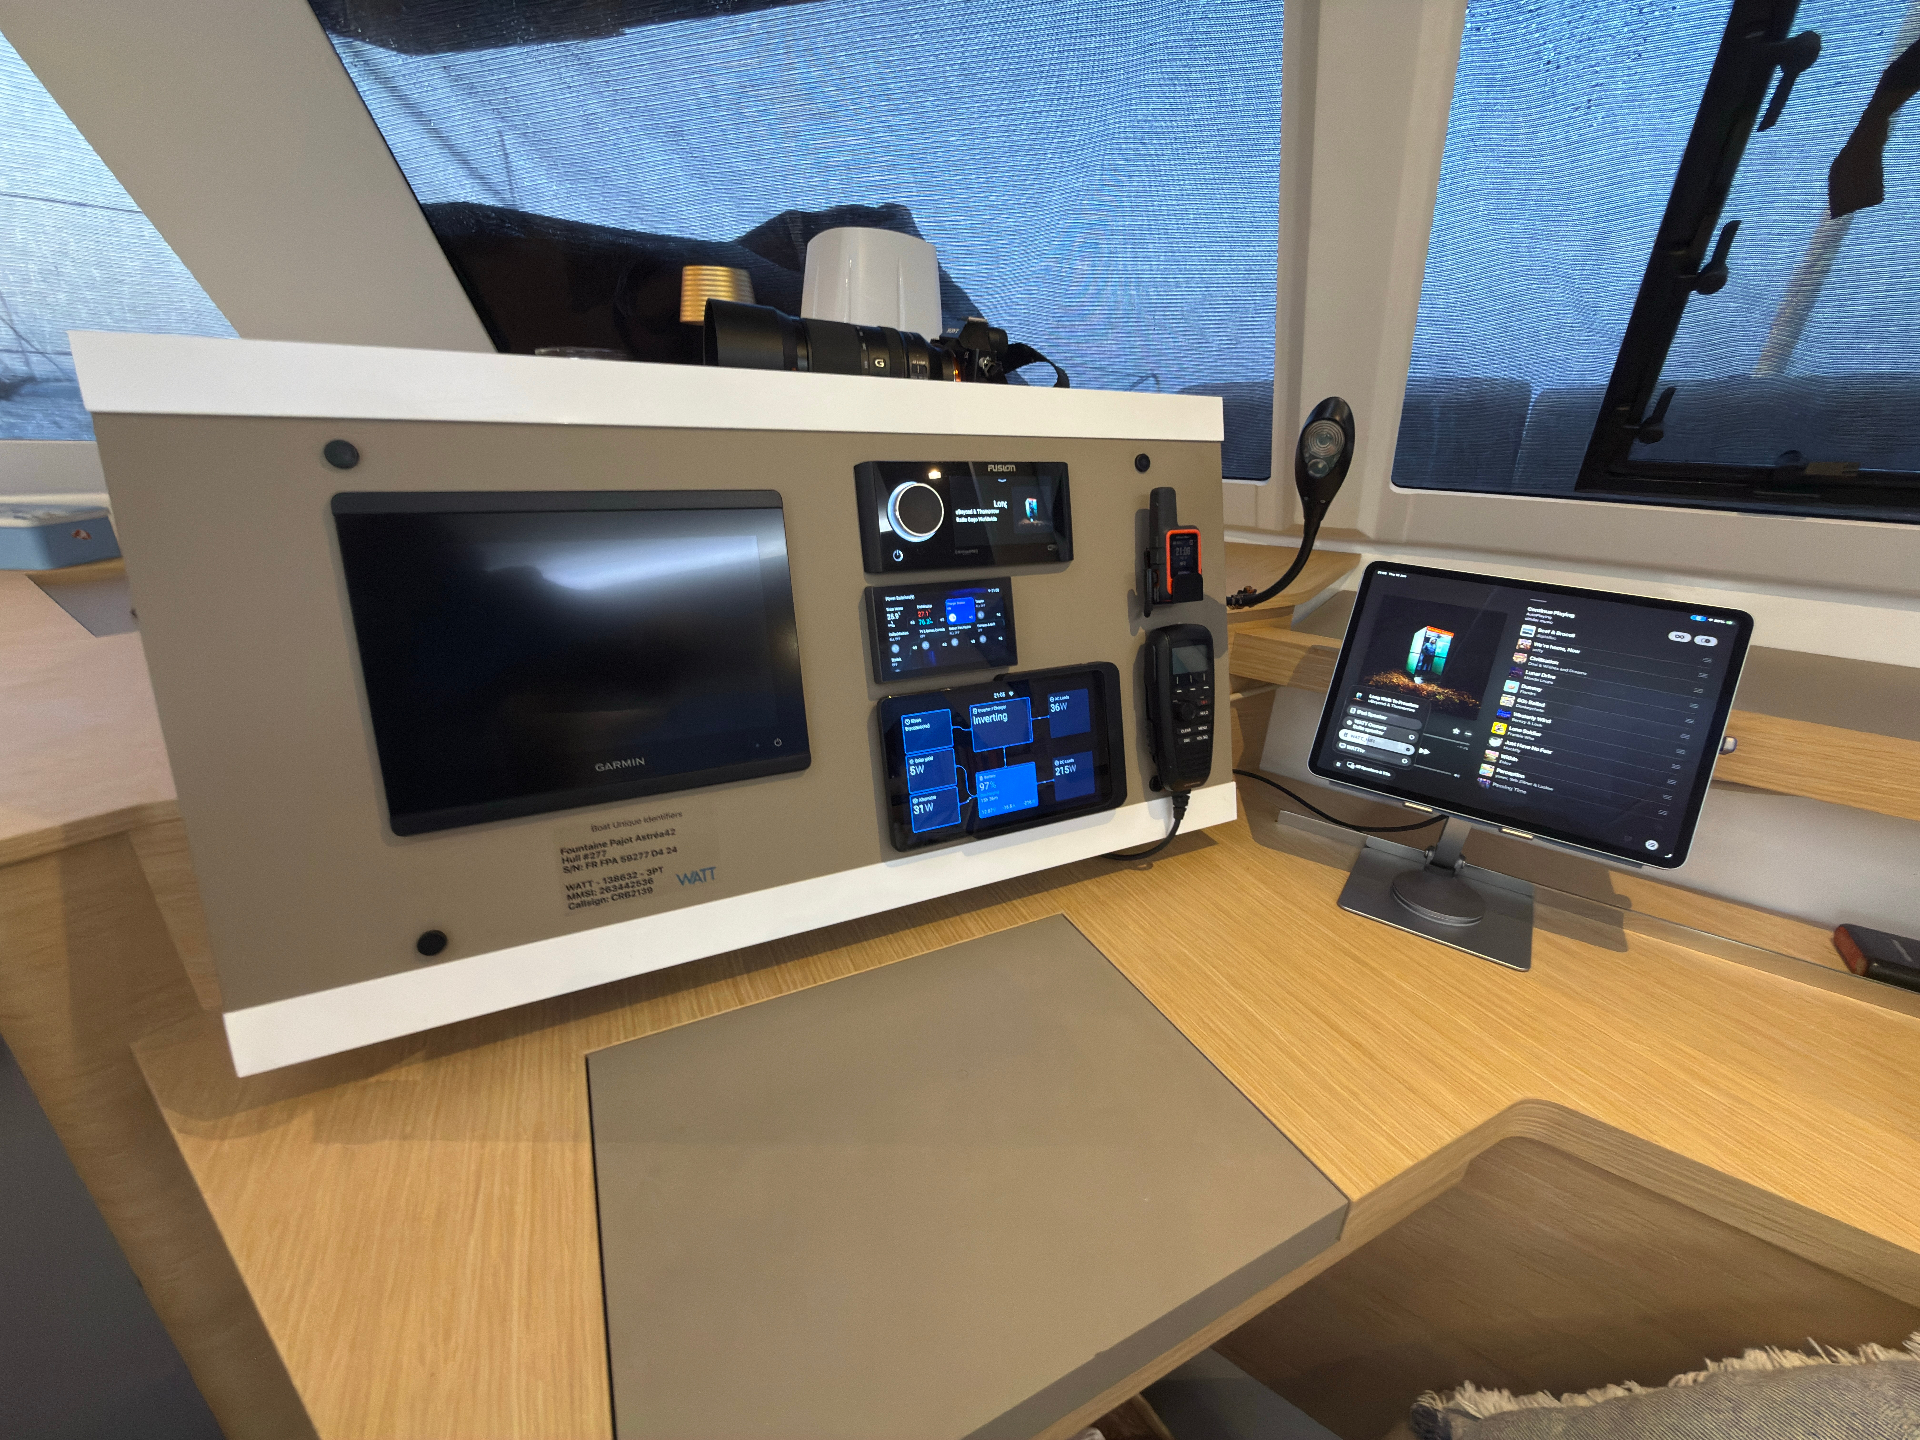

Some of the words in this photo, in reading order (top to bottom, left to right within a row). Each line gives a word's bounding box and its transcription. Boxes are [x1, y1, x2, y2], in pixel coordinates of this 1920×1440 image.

[874, 359, 885, 368] G
[1050, 702, 1068, 713] 36W
[973, 712, 1008, 726] Inverting
[1516, 742, 1531, 750] Have
[594, 757, 646, 772] GARMIN
[909, 764, 925, 776] 5W
[1054, 764, 1077, 777] 215W
[590, 822, 611, 833] Boat
[612, 818, 642, 829] Unique
[643, 811, 683, 824] Identifiers
[560, 840, 608, 856] Fountaine
[609, 836, 634, 847] Pajot
[561, 853, 581, 865] Hull
[582, 848, 607, 861] #277
[562, 863, 584, 875] S/N:
[585, 860, 598, 870] FR
[600, 857, 619, 867] FPA
[666, 846, 678, 855] 24
[564, 879, 593, 892] WATT
[646, 866, 664, 877] 3PT
[676, 866, 717, 887] WATT
[566, 888, 598, 901] MMSI:
[567, 896, 610, 911] Callsign:
